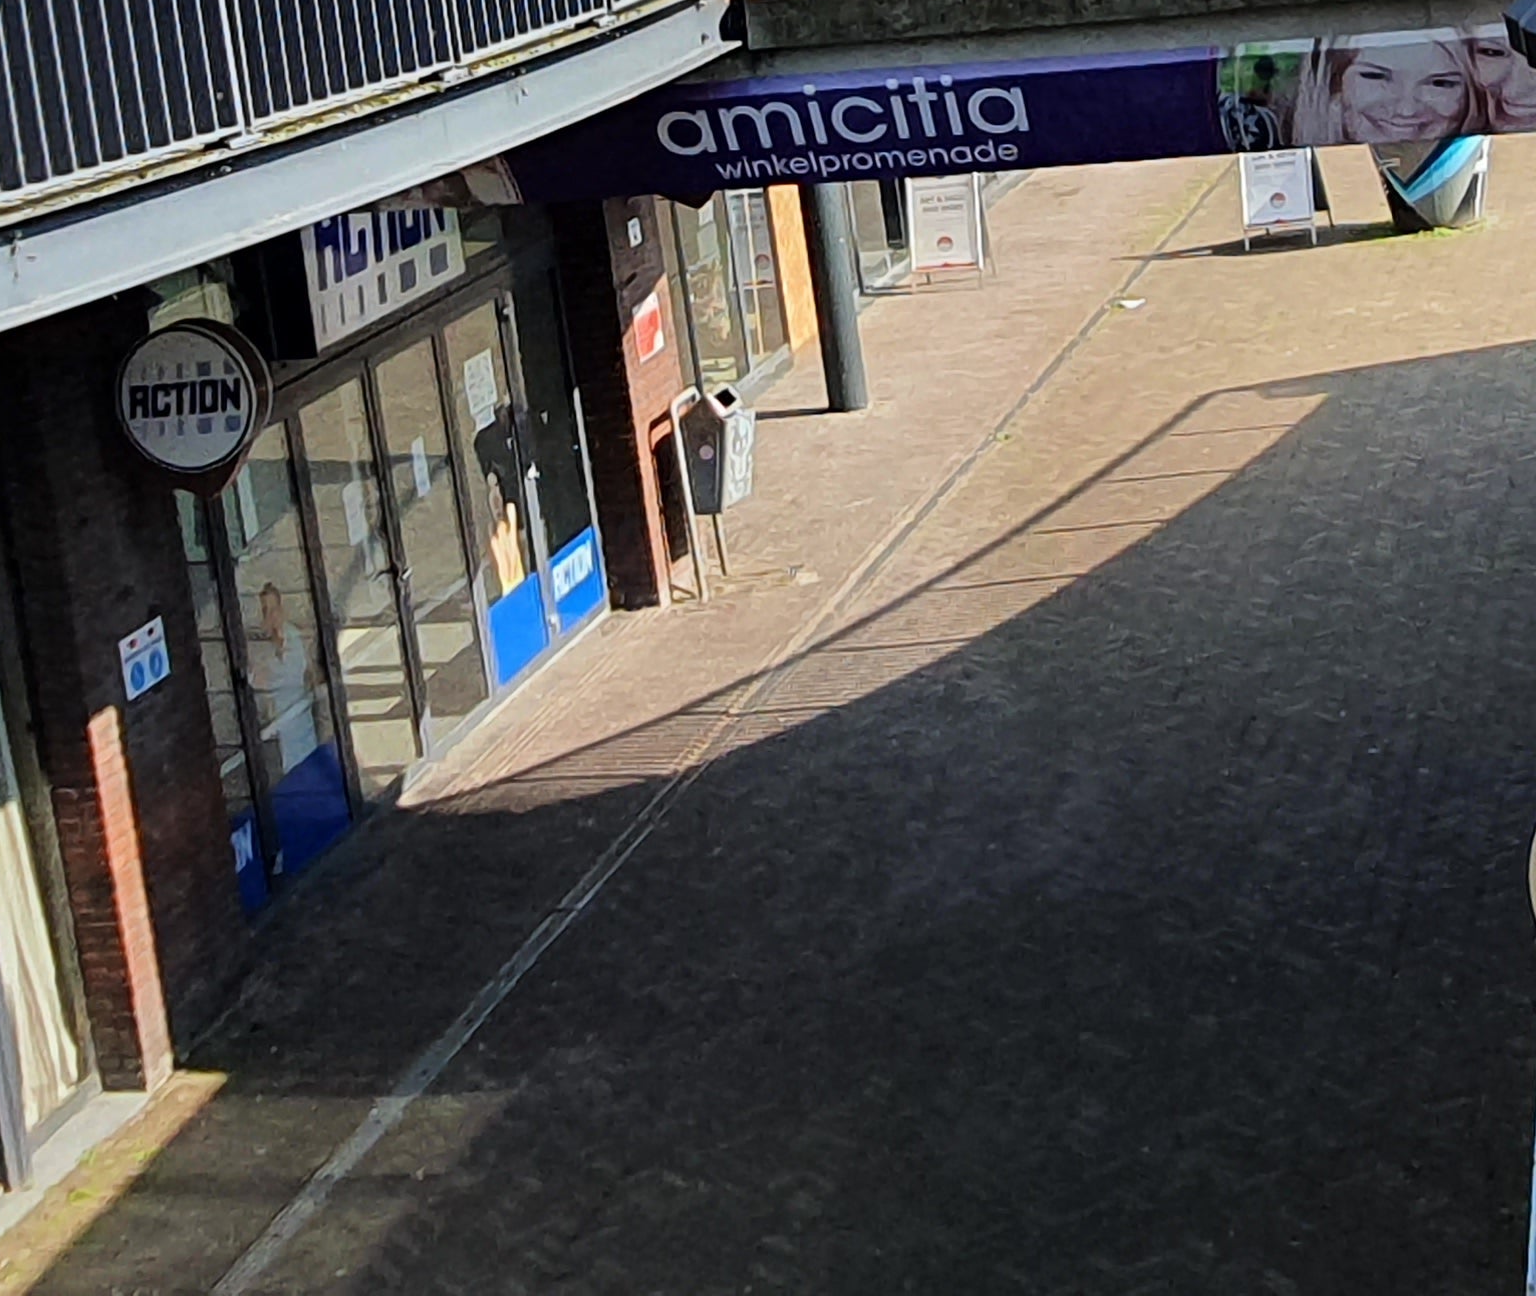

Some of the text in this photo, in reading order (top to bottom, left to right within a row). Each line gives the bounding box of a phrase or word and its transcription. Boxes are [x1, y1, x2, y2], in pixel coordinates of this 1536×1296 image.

[657, 75, 1029, 156] amicitia
[715, 138, 1019, 181] winkelpromenade
[128, 377, 242, 421] ACTION
